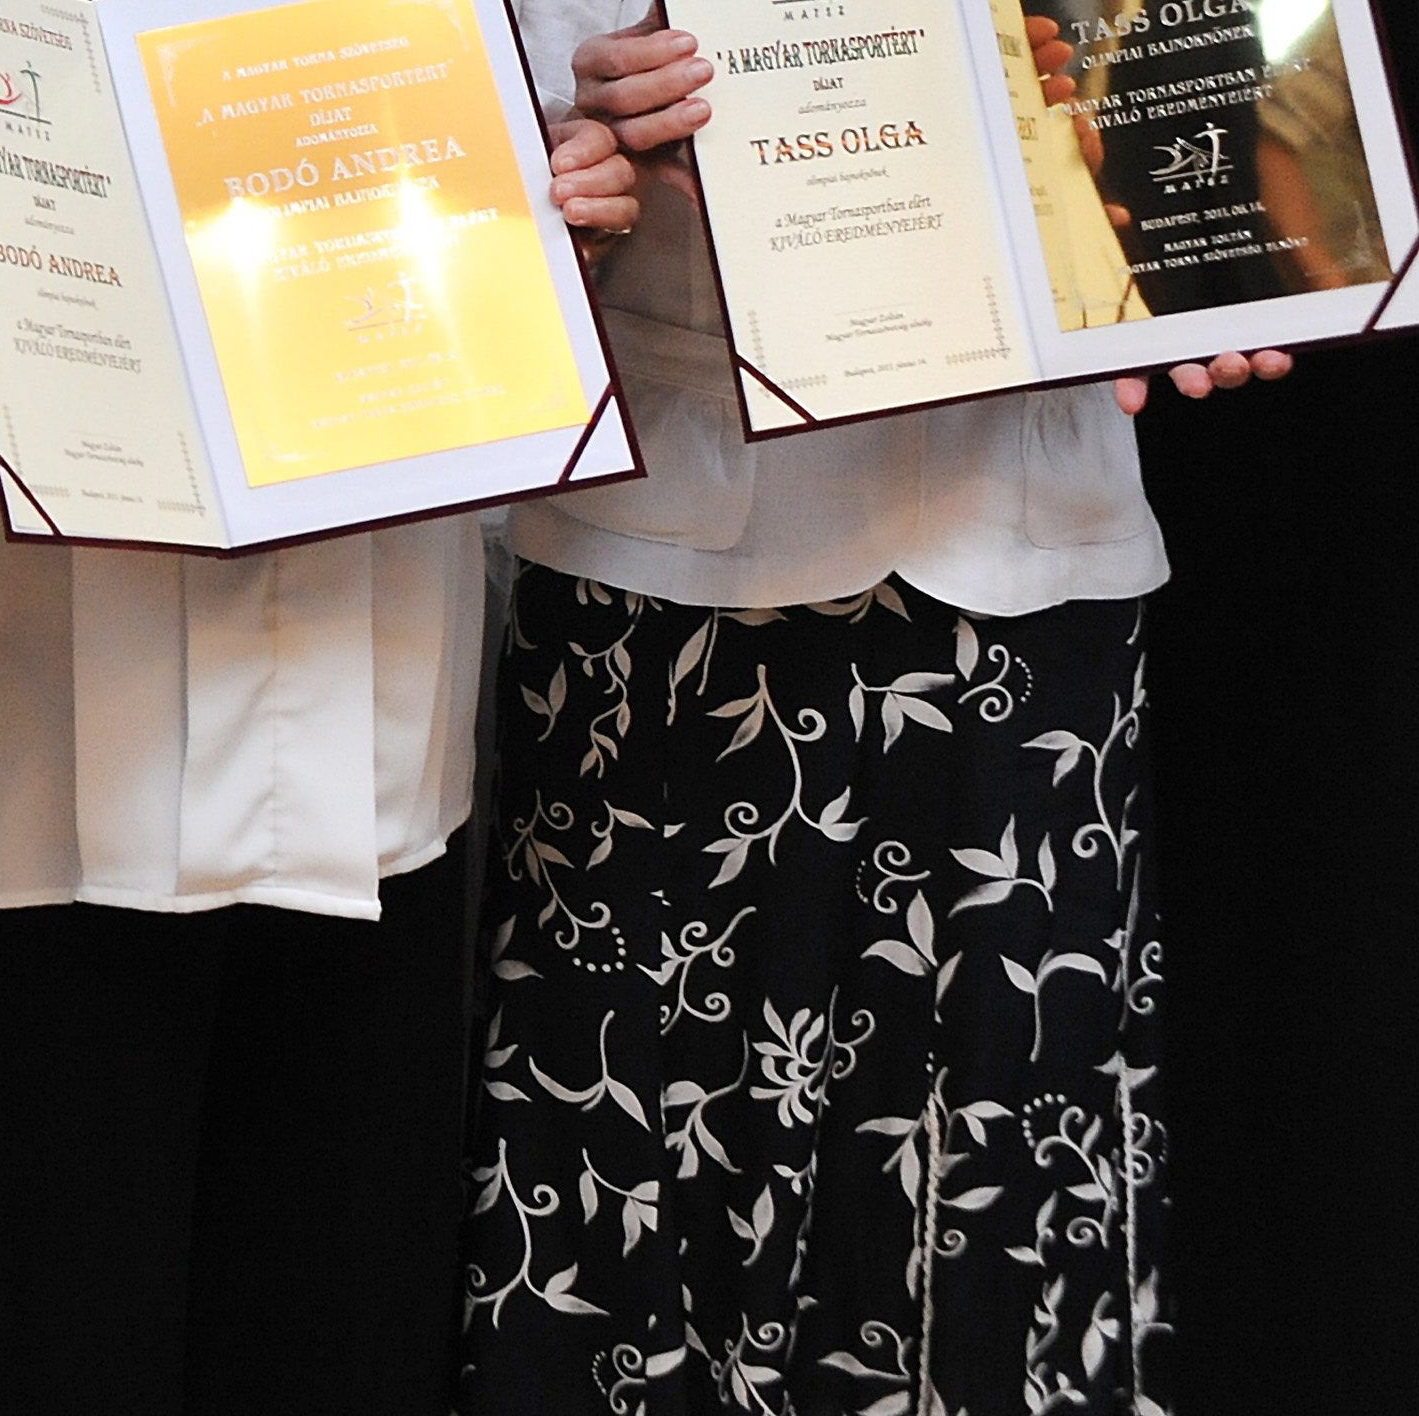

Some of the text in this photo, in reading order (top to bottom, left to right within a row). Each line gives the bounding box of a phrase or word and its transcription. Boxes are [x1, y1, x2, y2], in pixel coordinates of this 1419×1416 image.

[1069, 6, 1152, 48] TASS
[723, 23, 921, 75] A MAGYAR TORNASPORTÉRT
[811, 74, 845, 92] DÍJAT
[1125, 66, 1259, 105] TORNASPORTBAN
[217, 92, 295, 123] MAGYAR
[748, 119, 928, 167] TASS OLGA
[221, 156, 323, 202] BODÓ
[325, 132, 467, 183] ANDREA
[44, 251, 124, 289] ANDREA
